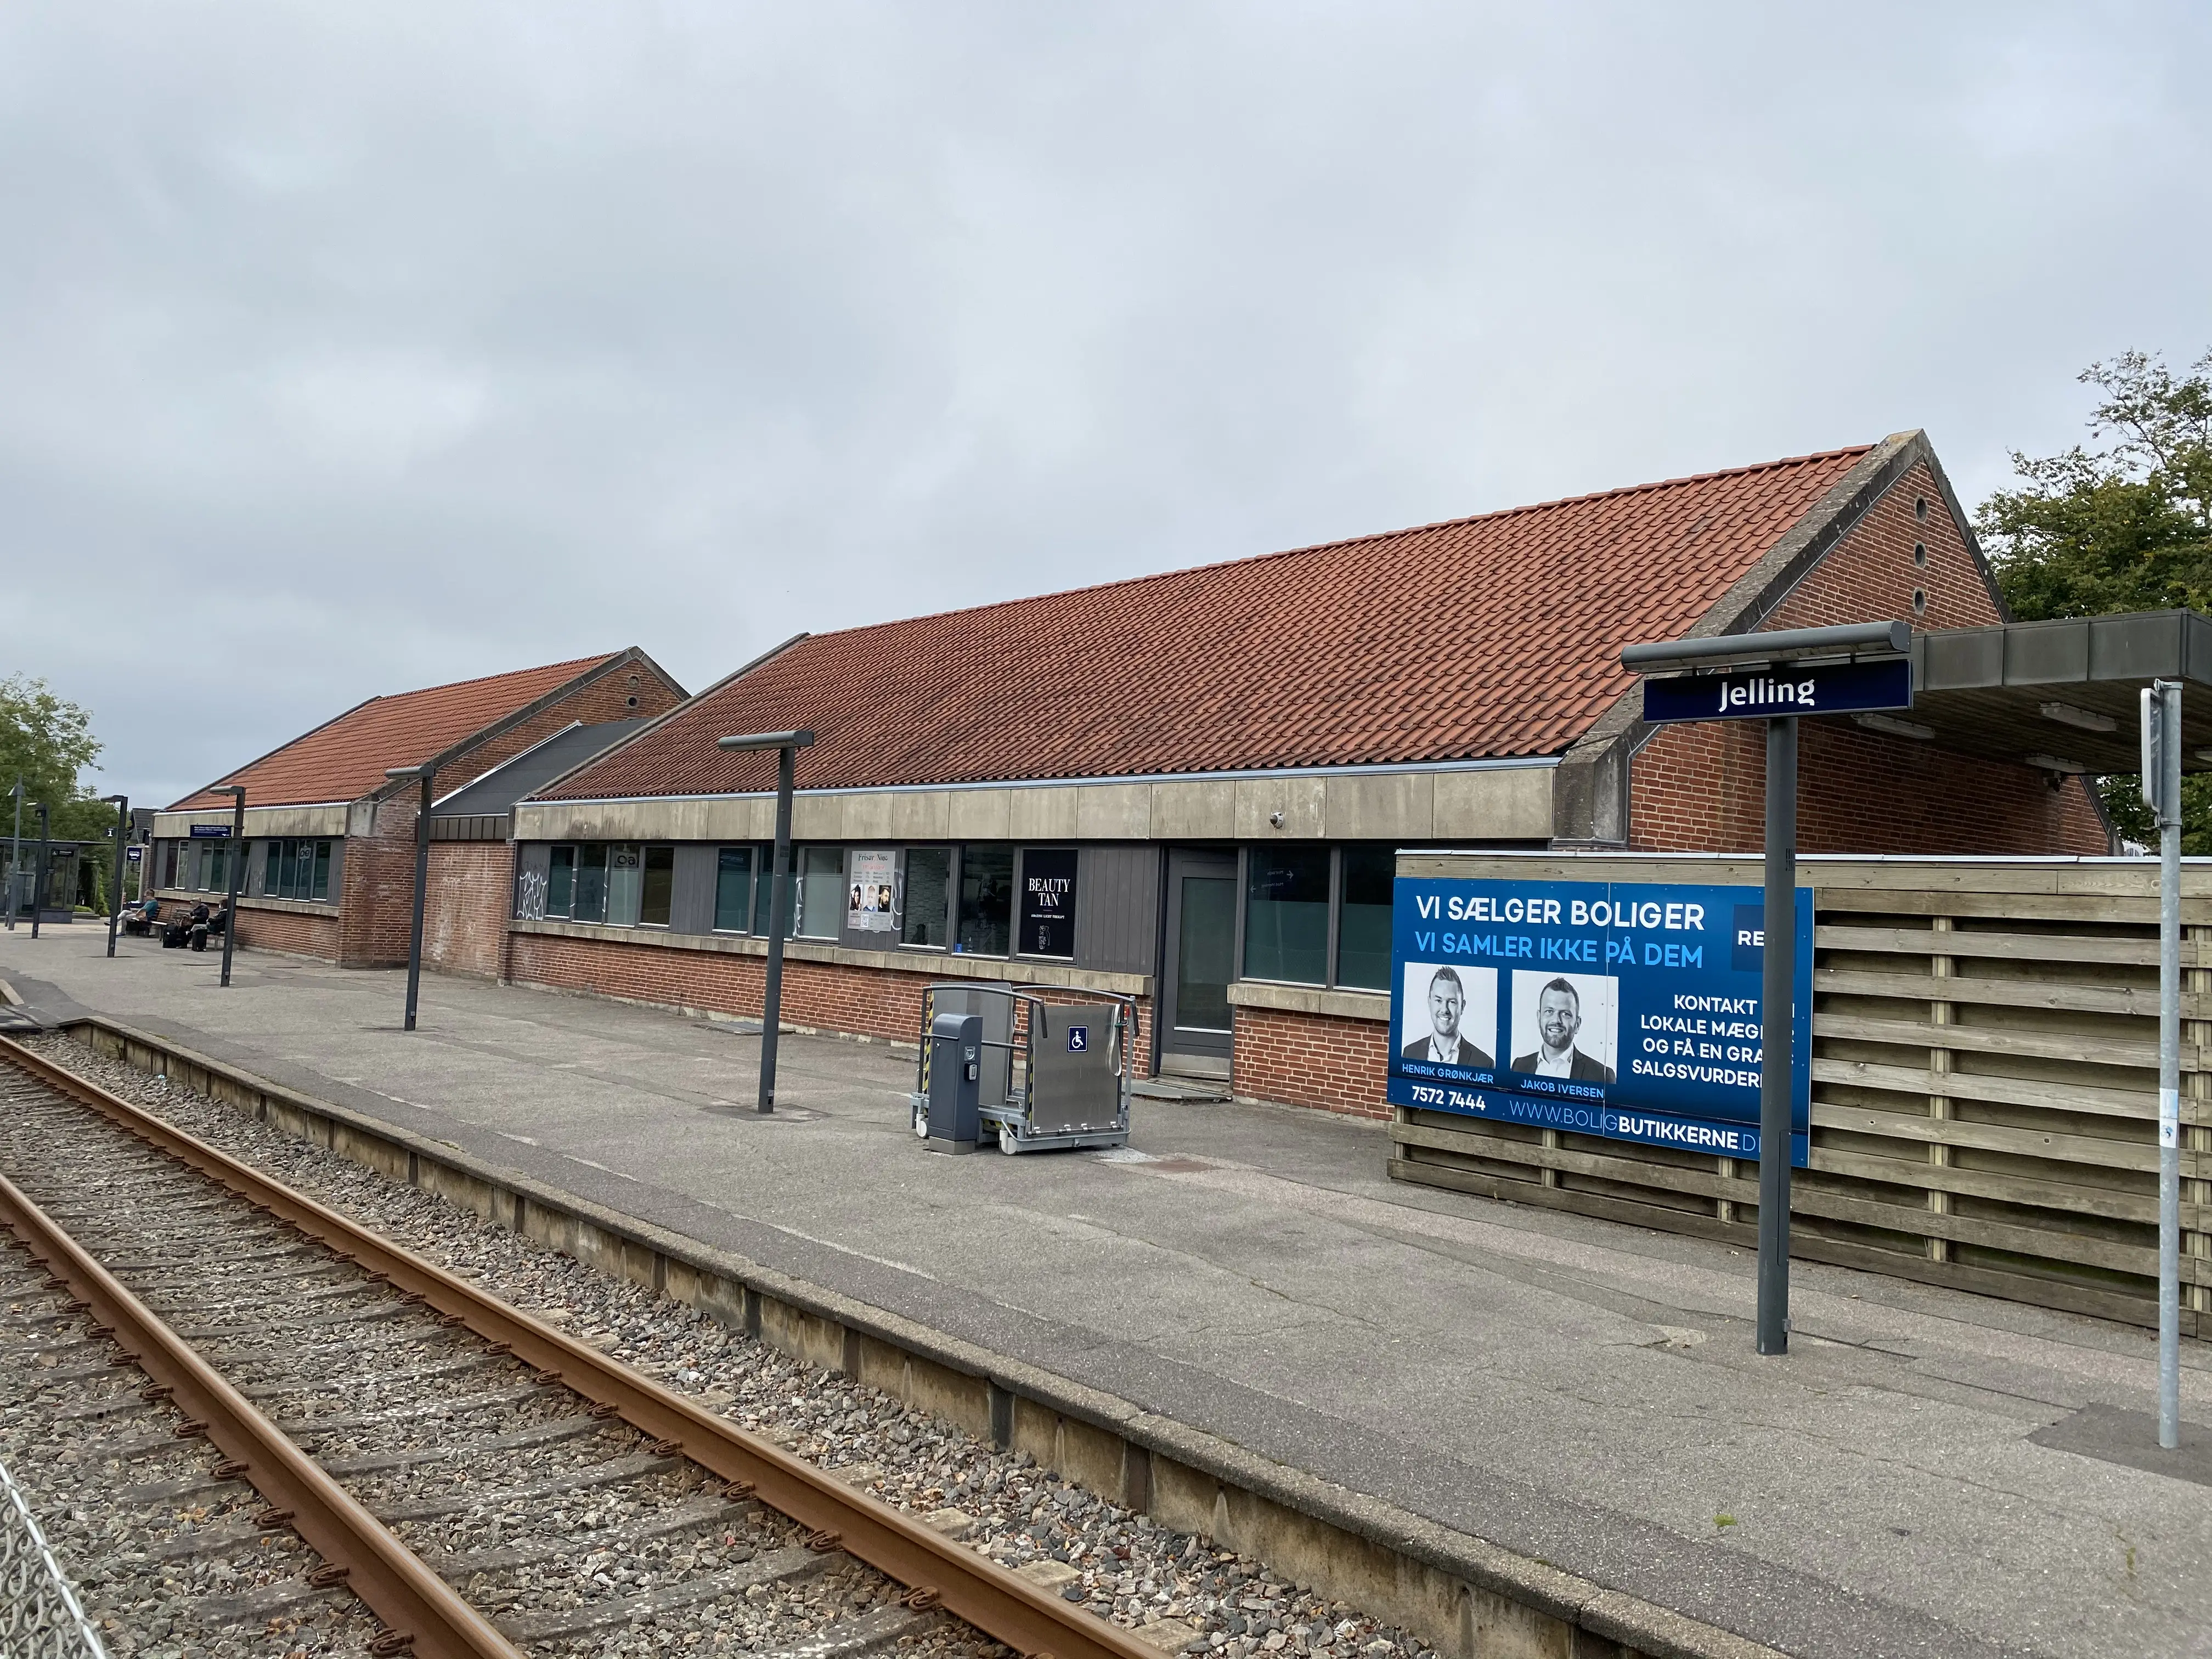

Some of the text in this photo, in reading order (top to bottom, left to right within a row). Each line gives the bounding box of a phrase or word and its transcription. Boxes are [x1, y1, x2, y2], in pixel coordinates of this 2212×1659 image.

[1718, 678, 1815, 712] Jelling
[1028, 878, 1071, 893] BEAUTY
[1038, 893, 1059, 906] TAN
[1415, 895, 1705, 930] VI SÆLGER BOLIGER
[1415, 931, 1702, 968] VI SAMLER IKKE PÅ DEM
[1674, 994, 1758, 1015] KONTAKT
[1641, 1014, 1707, 1034] LOKALE
[1643, 1037, 1669, 1054] OG
[1674, 1038, 1695, 1057] FÅ
[1700, 1043, 1722, 1060] EN
[1402, 1063, 1494, 1084] HENRIK GRØNKJÆR
[1412, 1086, 1486, 1111] 7572 7444
[1521, 1079, 1604, 1098] JAKOB IVERSEN
